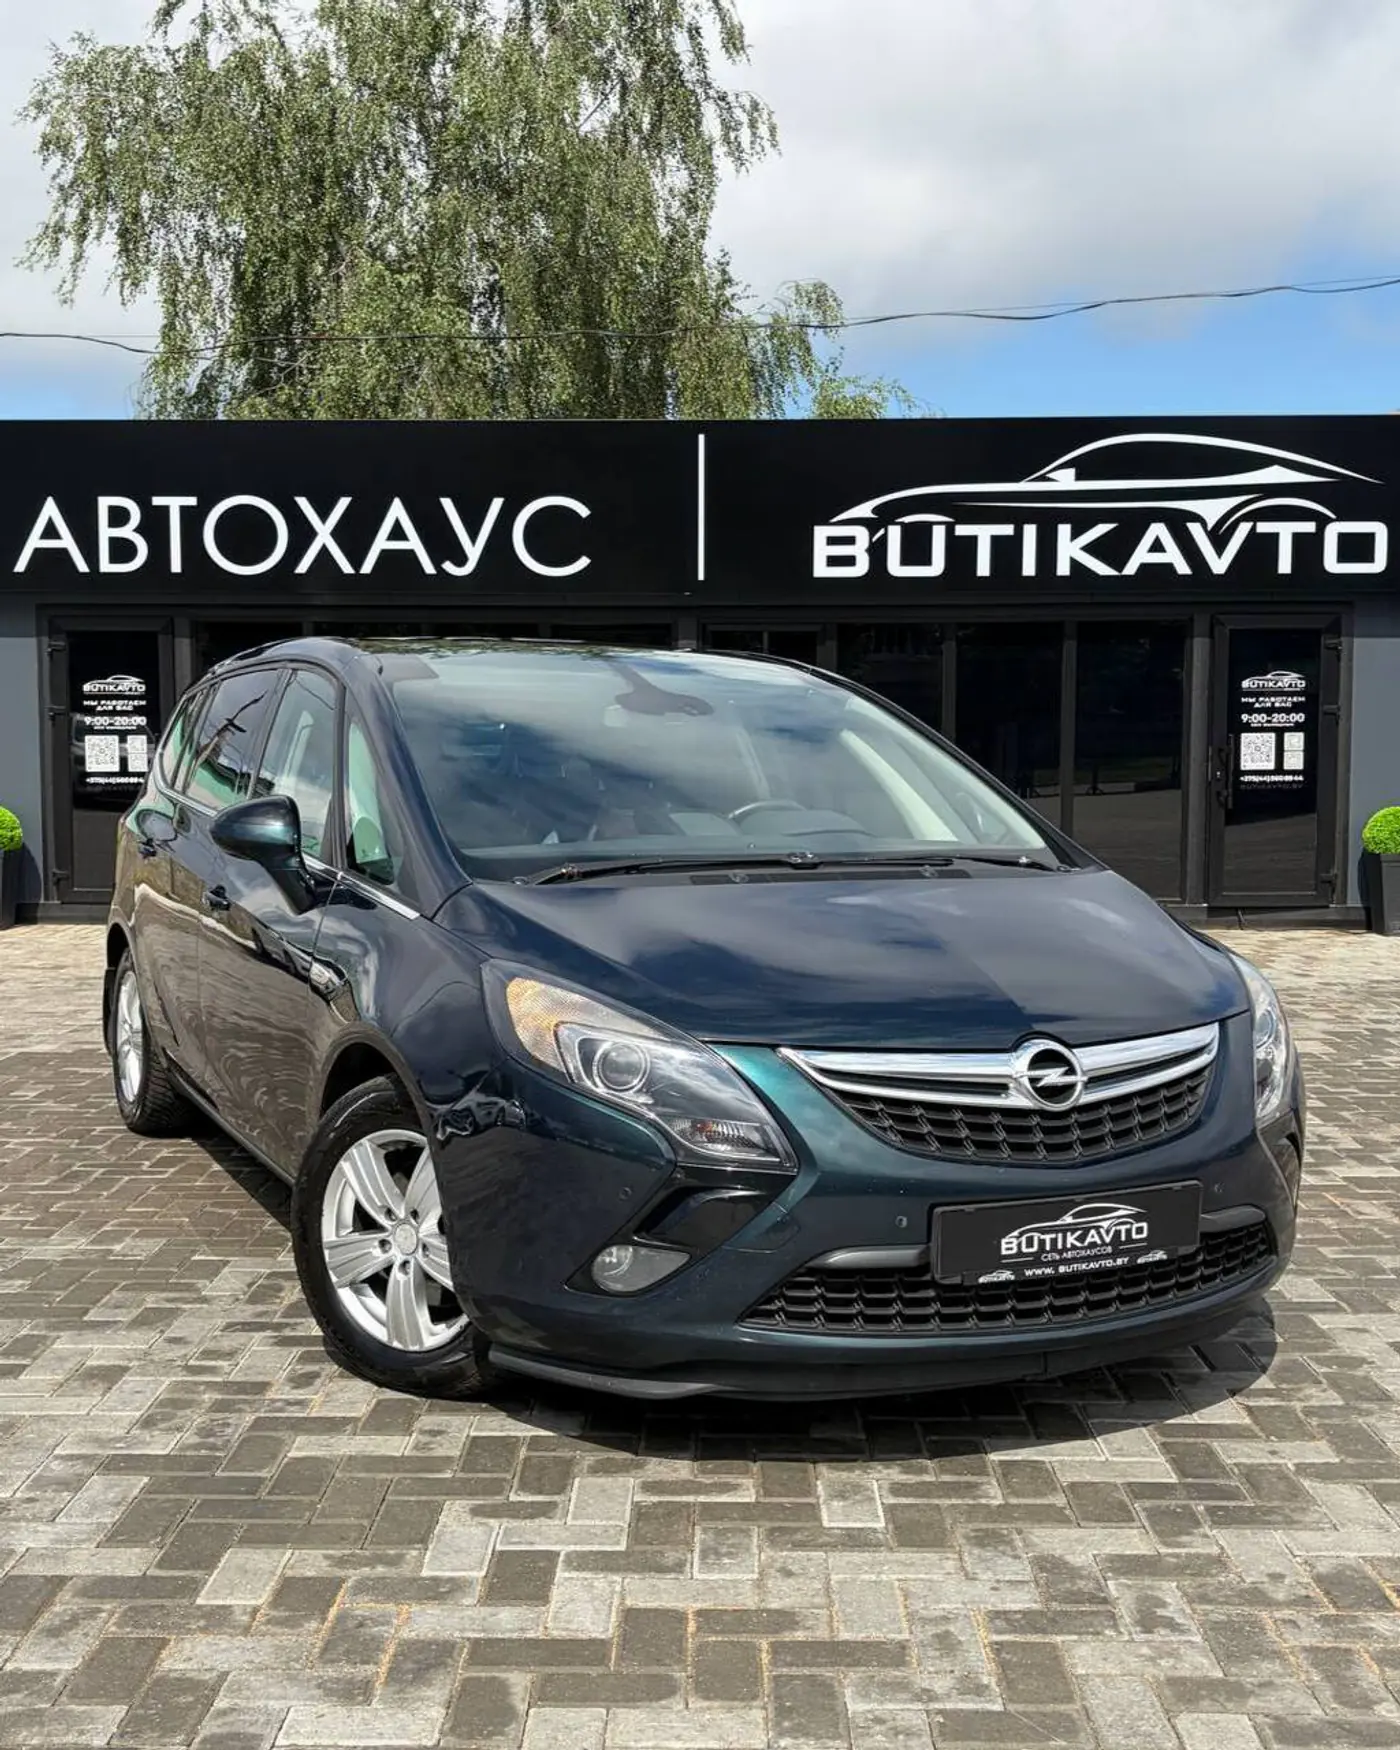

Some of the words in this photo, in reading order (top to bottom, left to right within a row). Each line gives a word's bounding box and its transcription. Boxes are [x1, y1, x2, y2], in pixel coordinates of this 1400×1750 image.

[12, 494, 593, 578] АВТОХАУС
[812, 520, 1389, 579] BUTIKAVTO
[1241, 679, 1306, 689] BUTIKAVTO
[84, 716, 147, 726] 9:00-20:00
[1241, 713, 1306, 723] 9:00-20:00
[1000, 1221, 1148, 1256] BUTIKAVTO
